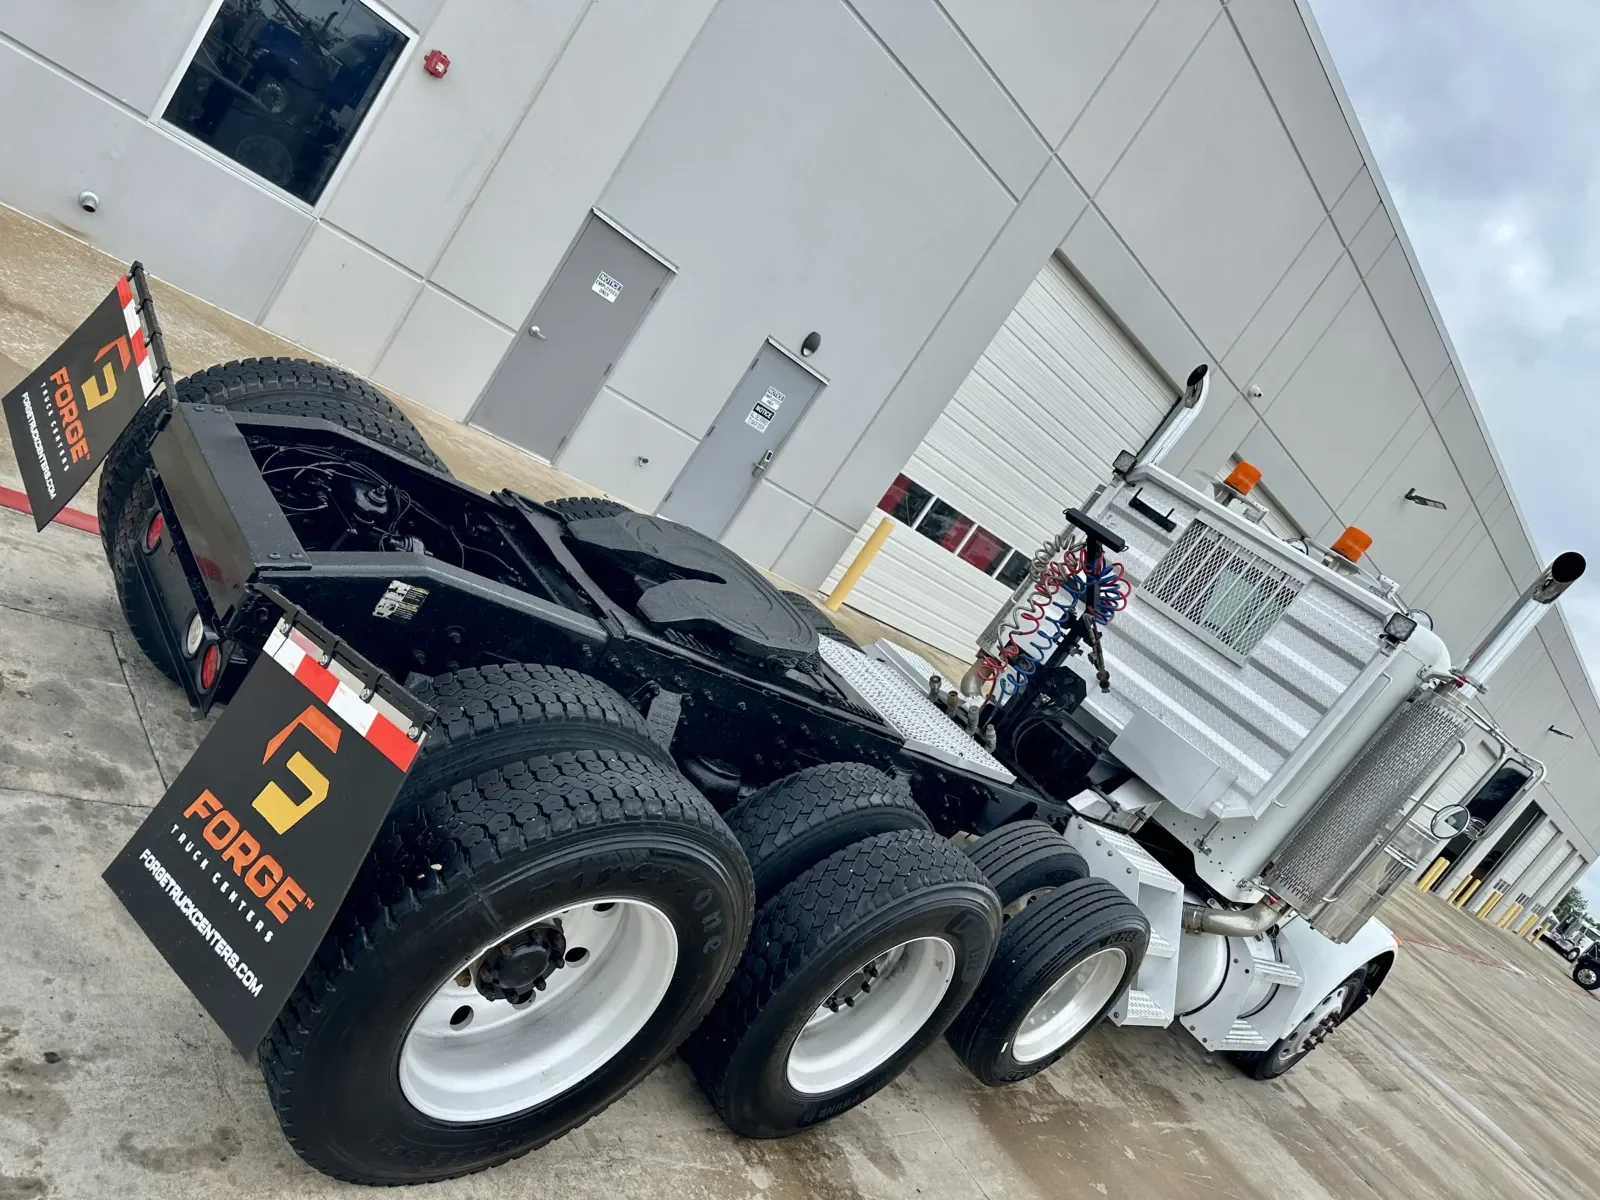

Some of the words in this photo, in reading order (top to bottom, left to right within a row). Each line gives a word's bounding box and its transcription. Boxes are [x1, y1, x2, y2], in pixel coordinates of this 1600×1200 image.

[599, 272, 621, 292] NOTICE
[40, 381, 54, 417] TRUCK
[50, 420, 69, 472] CENTERS
[50, 366, 90, 464] FORGE
[754, 404, 773, 419] NOTICE
[170, 824, 209, 870] TRUCK
[212, 872, 274, 942] CENTERS
[183, 788, 307, 924] FORGE
[139, 848, 263, 997] FORGETRUCKCENTERS.COM
